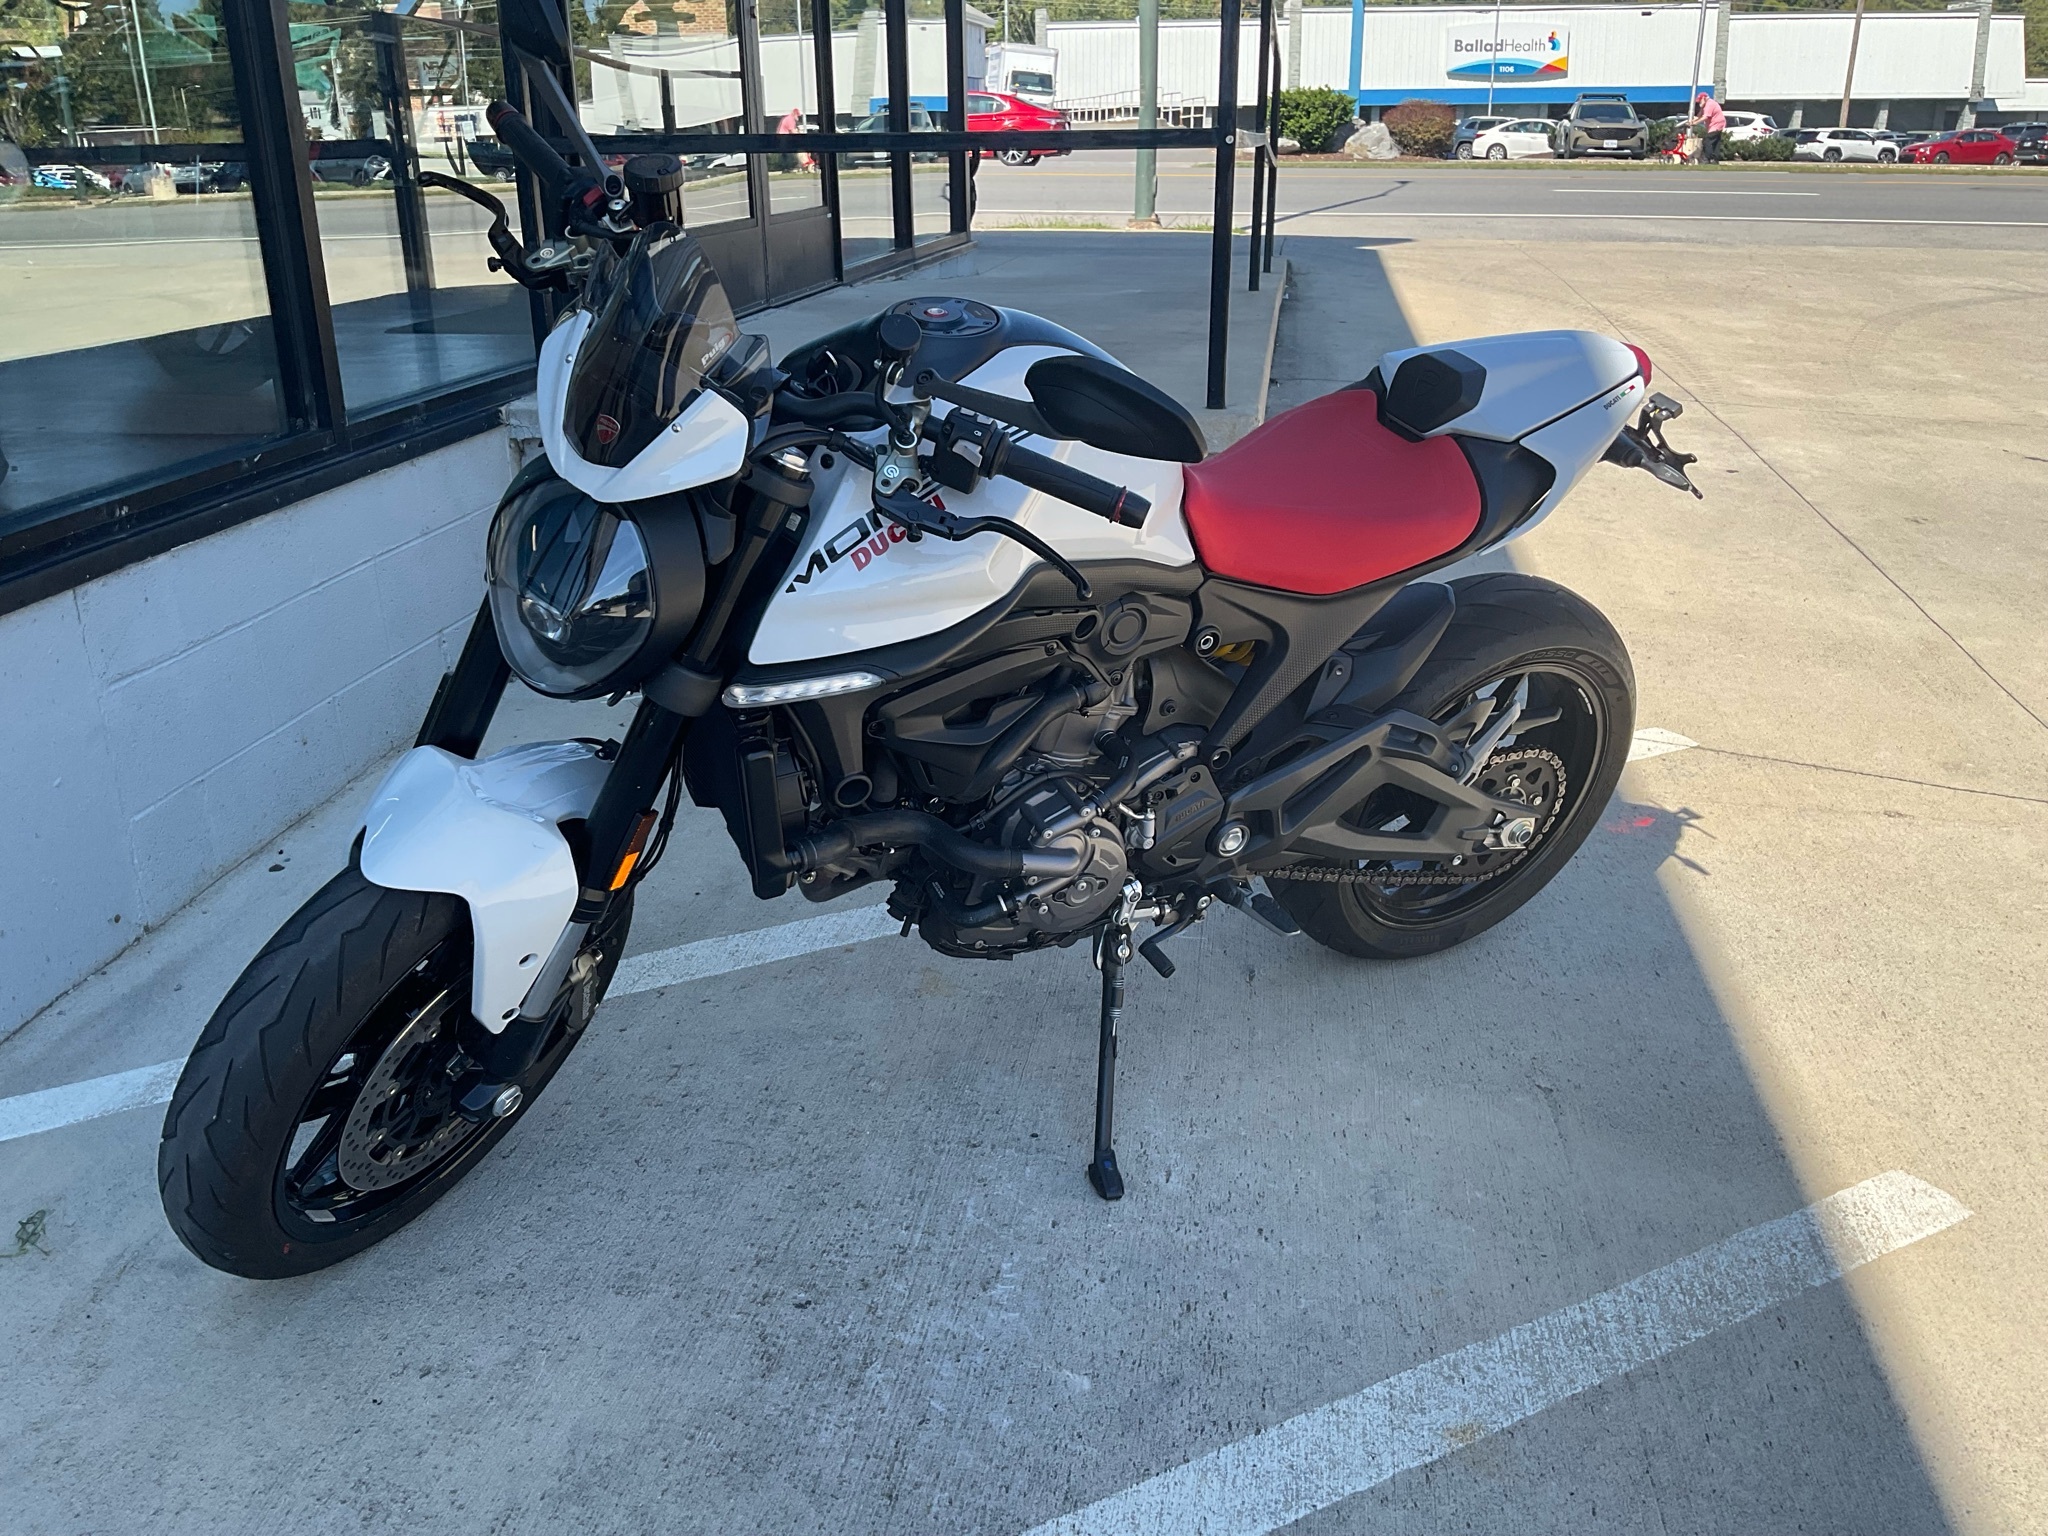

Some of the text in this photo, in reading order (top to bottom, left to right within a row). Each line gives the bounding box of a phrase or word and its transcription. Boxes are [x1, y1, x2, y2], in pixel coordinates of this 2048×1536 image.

[701, 337, 726, 366] Puig
[1603, 395, 1621, 410] DUCATI
[1522, 650, 1577, 662] ROSSO
